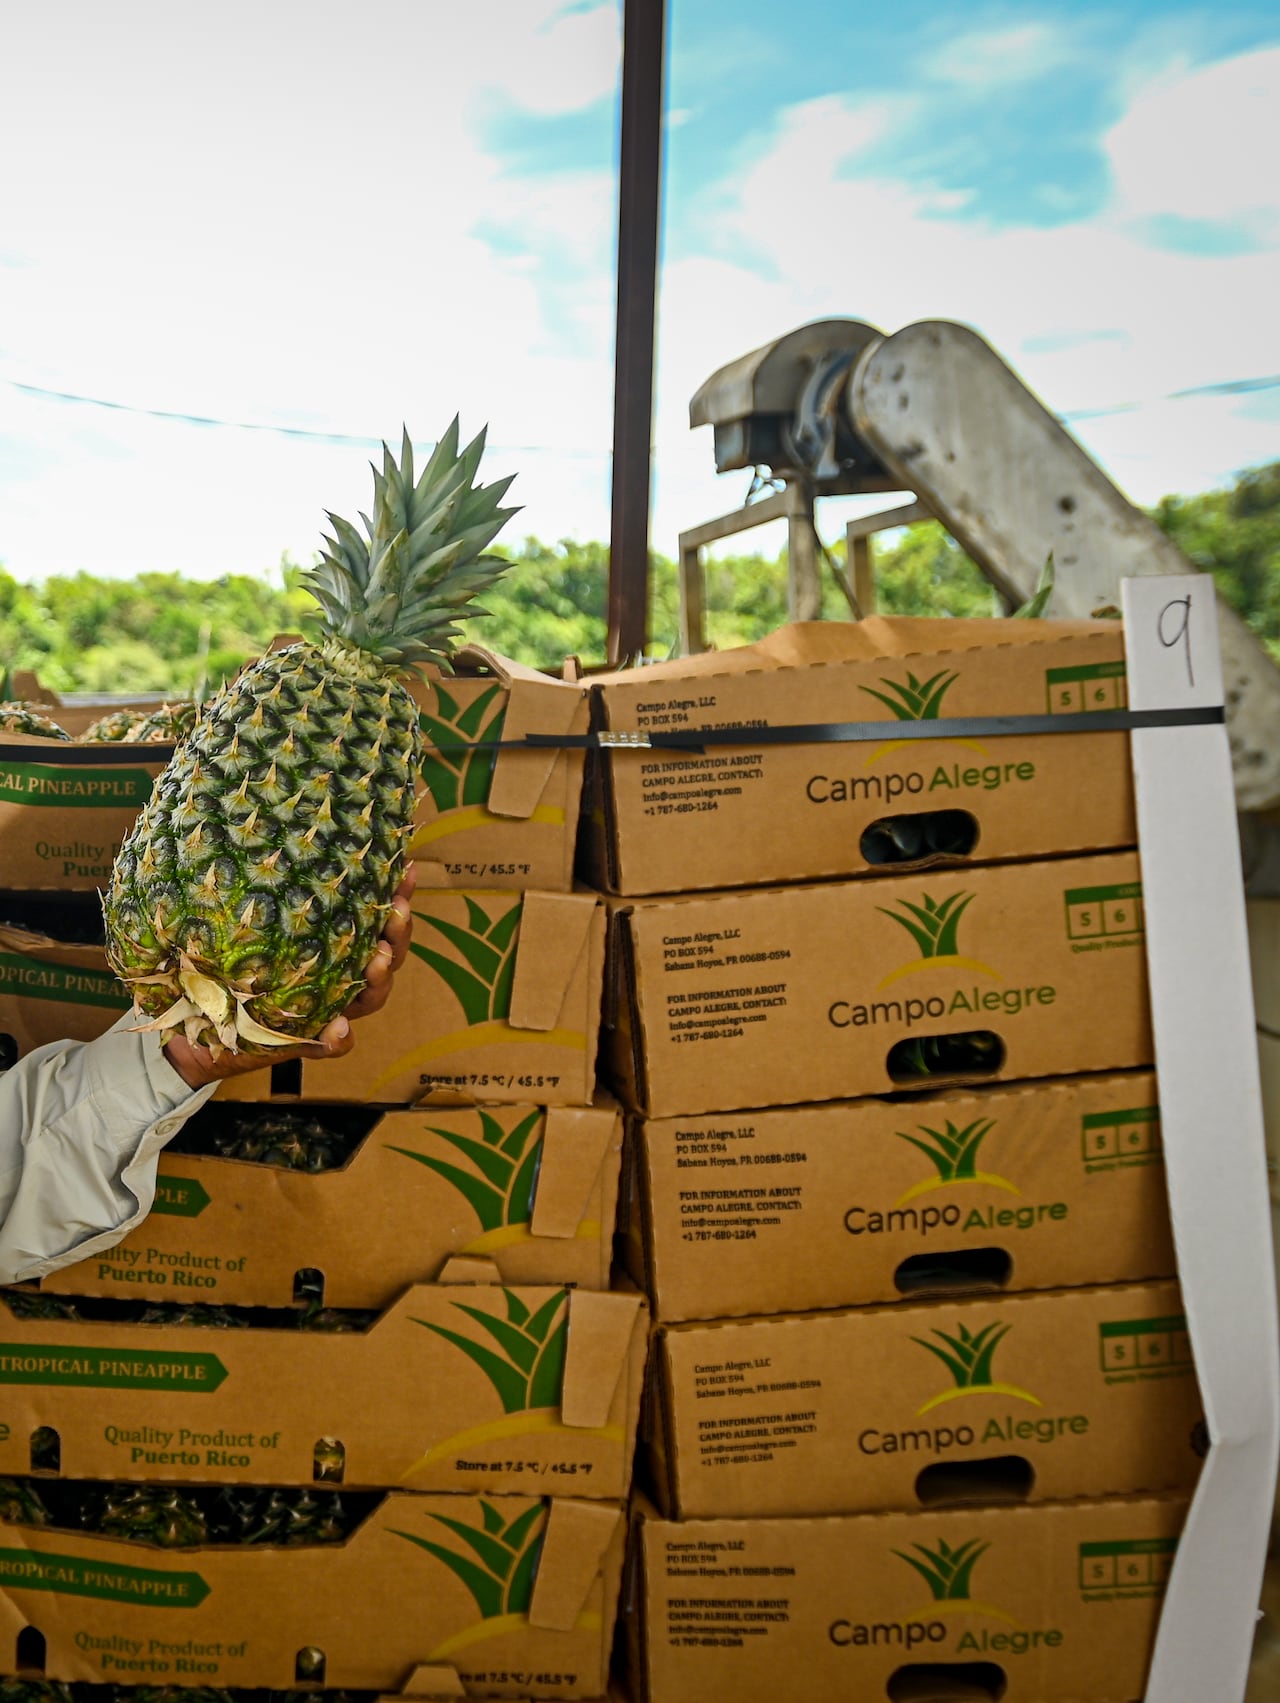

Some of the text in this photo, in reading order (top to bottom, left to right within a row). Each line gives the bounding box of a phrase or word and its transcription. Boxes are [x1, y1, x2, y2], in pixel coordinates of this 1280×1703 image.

[1158, 594, 1194, 687] 9
[637, 703, 666, 713] Campo
[699, 697, 716, 707] LLC
[1060, 688, 1105, 705] 5 6
[638, 713, 688, 726] PO BOX 594
[641, 755, 763, 774] FOR INFORMATION ABOUT
[28, 778, 136, 796] PINEAPPLE
[643, 777, 675, 788] CAMPO
[678, 773, 716, 784] ALEGRE,
[806, 761, 1035, 803] Campo Alegre
[35, 841, 104, 861] Quality
[64, 862, 112, 877] Puer
[445, 864, 462, 874] 7.5
[480, 864, 486, 876] /
[490, 864, 515, 874] 45.5
[1081, 909, 1126, 927] 5 6
[663, 935, 691, 945] Campo
[725, 929, 740, 938] LLC
[664, 946, 714, 958] PO BOX 594
[726, 956, 737, 964] PR
[65, 975, 128, 997] PINEA
[668, 984, 786, 1004] FOR INFORMATION ABOUT
[668, 1006, 701, 1017] CAMPO
[704, 1002, 740, 1013] ALEGRE,
[828, 985, 1056, 1027] Campo Alegre
[420, 1074, 452, 1084] Store
[455, 1075, 467, 1084] at
[470, 1075, 488, 1085] 7.5
[508, 1075, 514, 1088] /
[518, 1076, 543, 1086] 45.5
[676, 1132, 705, 1142] Campo
[738, 1128, 755, 1138] LLC
[1096, 1131, 1140, 1150] 5 6
[677, 1144, 727, 1154] PO BOX 594
[740, 1156, 752, 1165] PR
[680, 1187, 802, 1200] FOR INFORMATION ABOUT
[681, 1204, 713, 1214] CAMPO
[844, 1202, 1068, 1236] Campo Alegre
[147, 1248, 222, 1270] Product
[226, 1257, 247, 1271] of
[98, 1264, 216, 1288] Puerto Rico
[99, 1361, 207, 1380] PINEAPPLE
[695, 1365, 722, 1374] Campo
[755, 1358, 771, 1367] LLC
[696, 1378, 707, 1386] PO
[710, 1376, 728, 1385] BOX
[719, 1415, 783, 1427] INFORMATION
[785, 1412, 816, 1422] ABOUT
[104, 1425, 280, 1448] Quality Product of
[700, 1432, 732, 1441] CAMPO
[858, 1415, 1089, 1455] Campo Alegre
[131, 1448, 250, 1467] Puerto Rico
[456, 1460, 487, 1471] Store
[490, 1462, 502, 1471] at
[506, 1461, 523, 1472] 7.5
[542, 1464, 548, 1475] /
[552, 1464, 577, 1474] 45.5
[85, 1571, 189, 1597] PINEAPPLE
[75, 1631, 247, 1657] Quality Product of
[829, 1619, 1064, 1654] Campo Alegre
[101, 1654, 219, 1673] Puerto Rico
[490, 1674, 507, 1683] 7.5
[526, 1674, 533, 1685] /
[536, 1675, 561, 1685] 45.5
